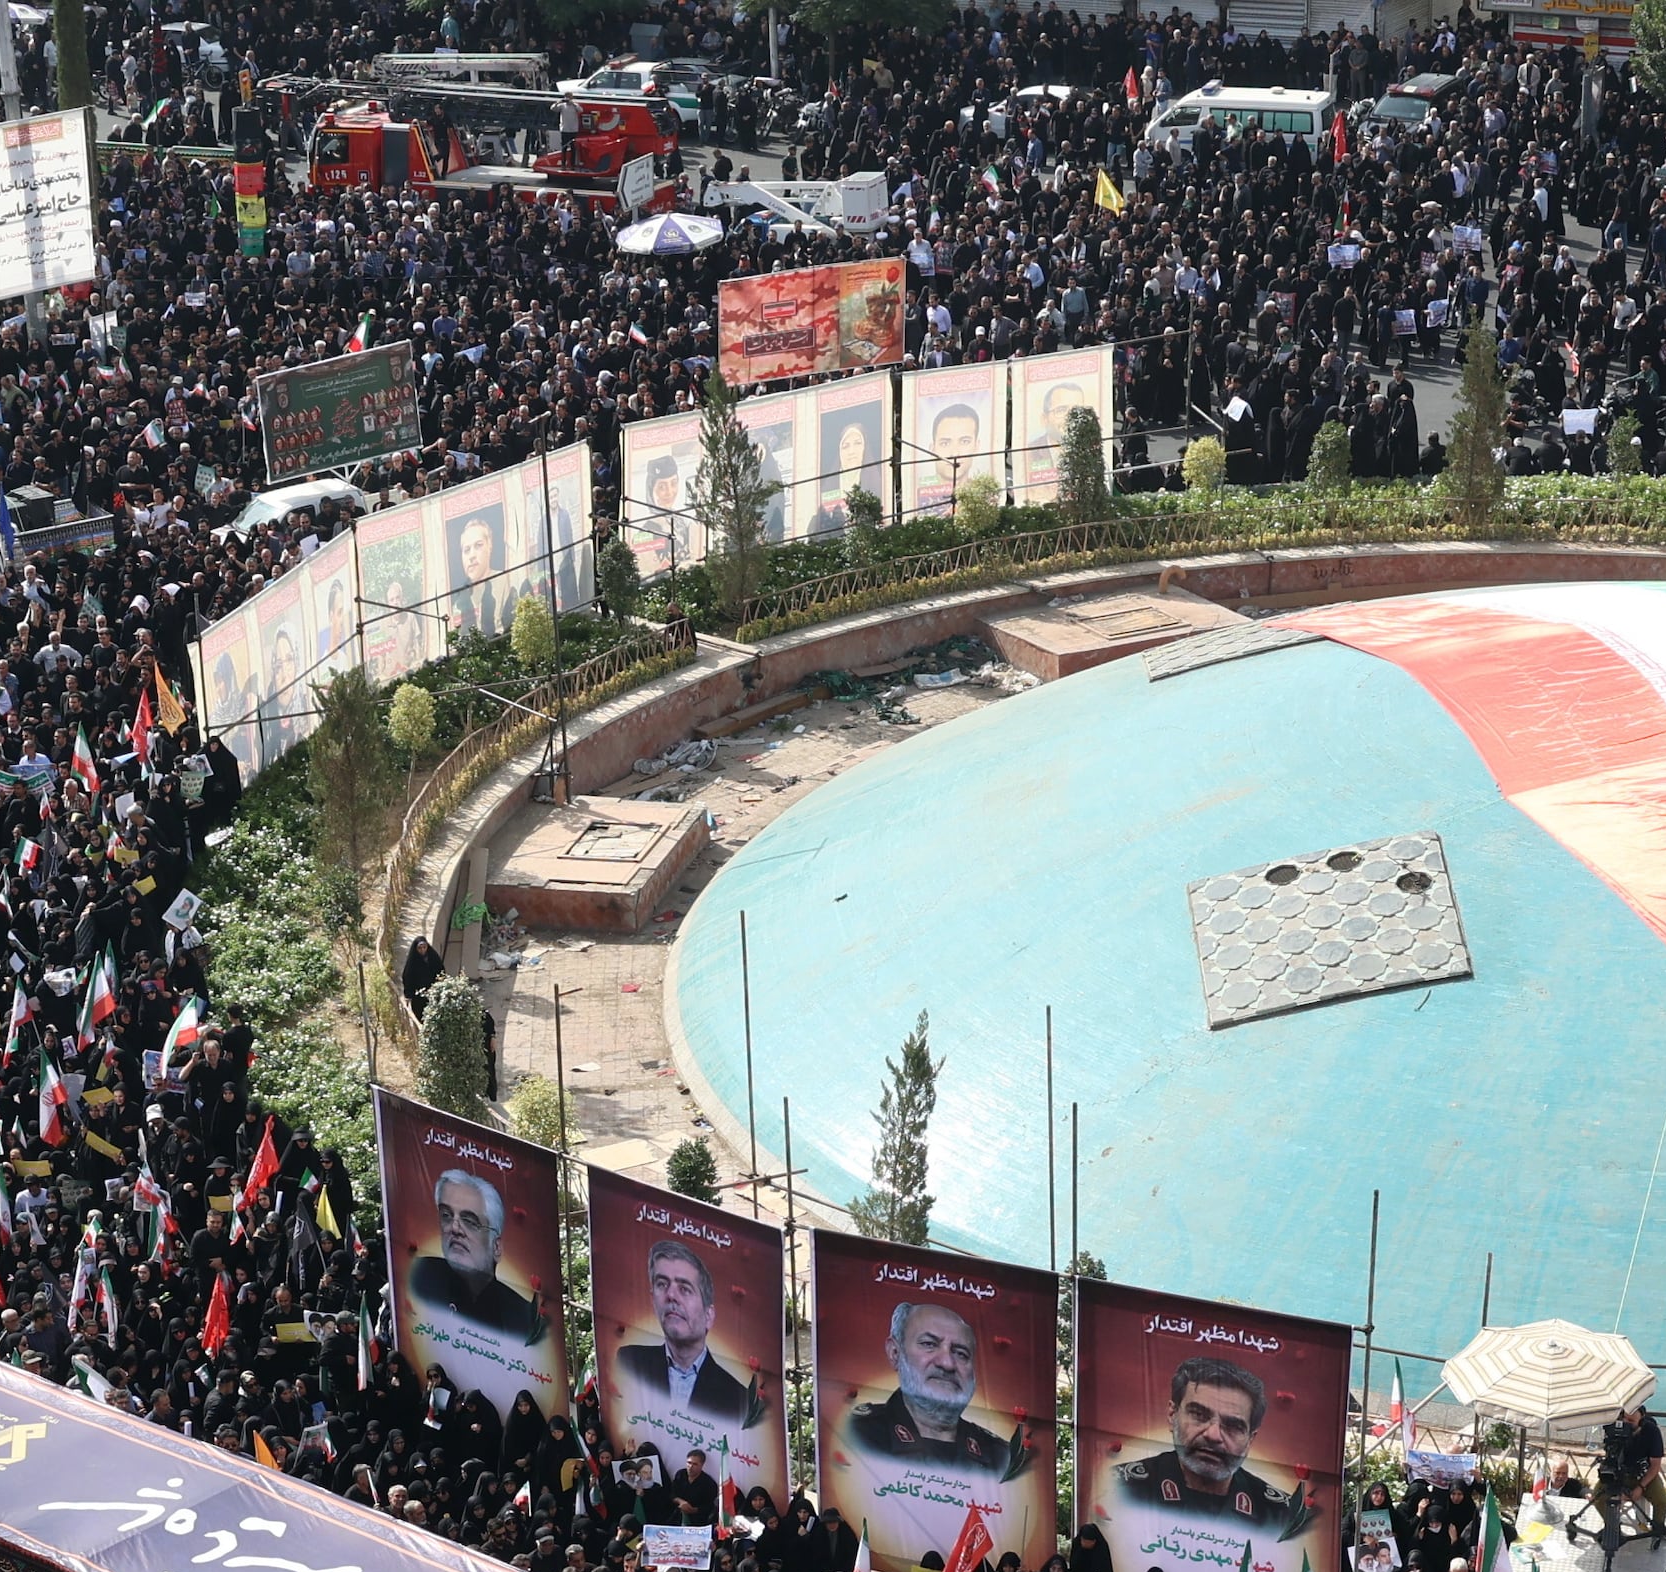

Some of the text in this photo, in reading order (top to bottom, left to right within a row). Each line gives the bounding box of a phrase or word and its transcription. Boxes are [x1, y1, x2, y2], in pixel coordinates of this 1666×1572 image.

[331, 170, 347, 180] 125
[34, 195, 55, 218] امیر
[57, 192, 81, 212] حاج
[424, 1128, 513, 1171] شهدا مظهر اقتدار
[636, 1204, 731, 1248] شهدا مظهر اقتدار
[874, 1263, 995, 1299] شهدا مظهر اقتدار
[410, 1319, 450, 1350] طهرانچی
[1144, 1314, 1279, 1352] شهدا مظهر اقتدار
[507, 1355, 527, 1375] دکتر
[527, 1366, 553, 1385] شهید
[626, 1413, 760, 1467] شهید کتر فریدون عباسی
[873, 1479, 1003, 1515] شهید محمد کاظمی
[1189, 1548, 1233, 1568] مهدی
